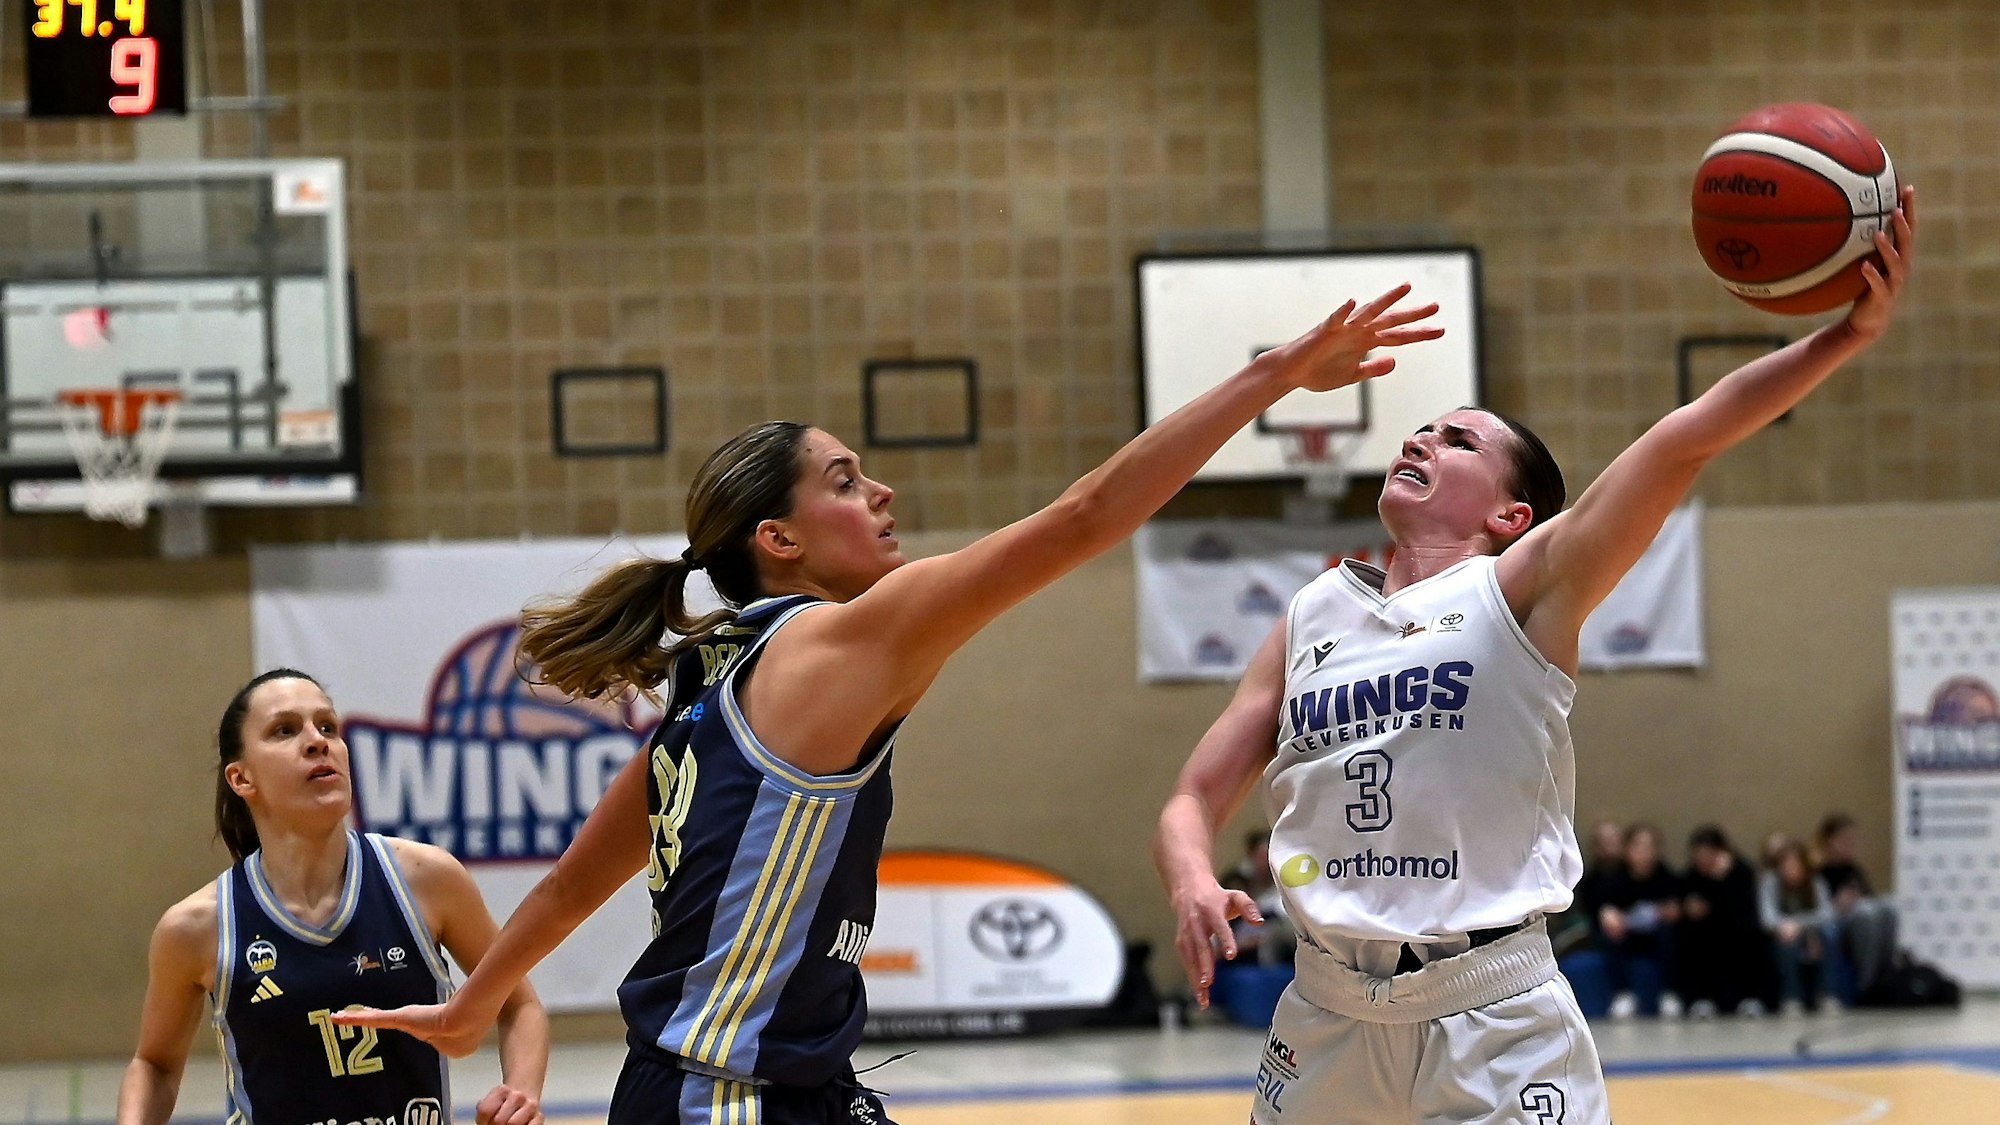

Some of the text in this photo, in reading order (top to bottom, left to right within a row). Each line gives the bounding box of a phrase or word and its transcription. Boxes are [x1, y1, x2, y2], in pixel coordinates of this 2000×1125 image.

[109, 37, 157, 115] 9
[1703, 173, 1777, 197] molten
[1290, 661, 1474, 739] WINGS
[1291, 714, 1464, 752] LEVERKUSEN
[352, 729, 642, 824] WING
[1344, 749, 1392, 832] 3
[1326, 849, 1458, 880] orthomol
[308, 1004, 384, 1078] 12
[1270, 1032, 1297, 1069] WGL
[1256, 1062, 1285, 1114] EVL
